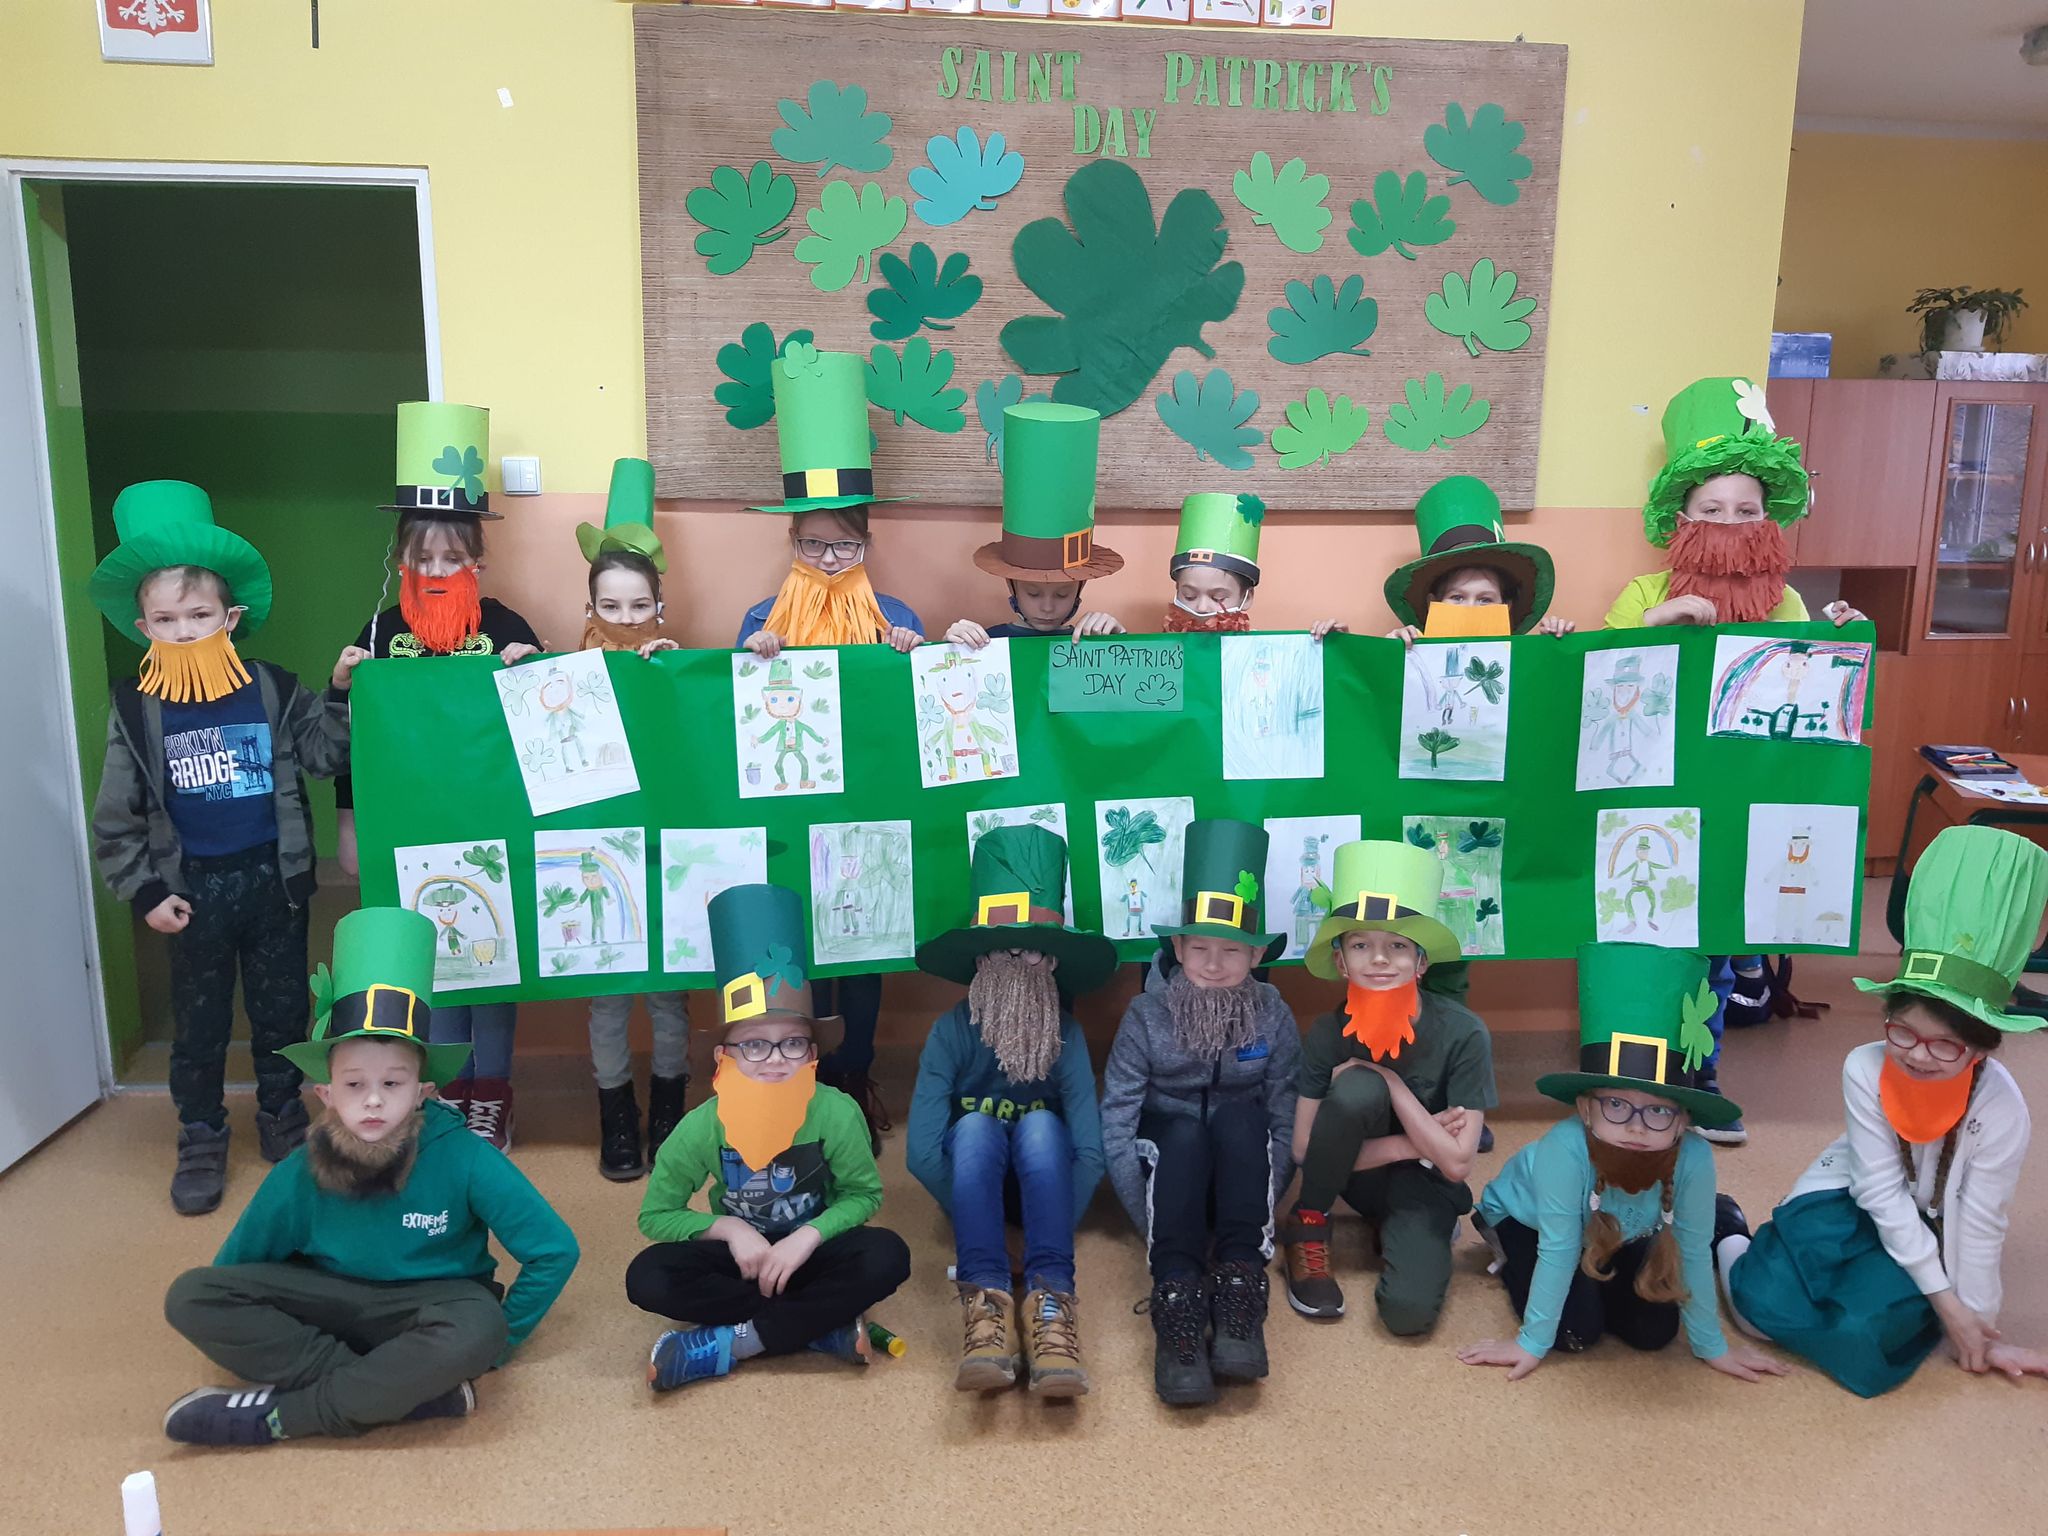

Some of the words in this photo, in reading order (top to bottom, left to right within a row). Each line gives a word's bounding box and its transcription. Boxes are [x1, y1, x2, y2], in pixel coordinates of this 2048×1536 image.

[937, 46, 1081, 103] SAINT
[1163, 51, 1393, 116] PATRICK'S
[1072, 104, 1157, 158] DAY
[1052, 643, 1105, 668] SAINT
[1108, 644, 1184, 670] PATRICK'S
[1083, 673, 1126, 696] DAY
[169, 749, 241, 789] BRIDGE
[205, 782, 232, 801] NYC
[402, 1209, 448, 1230] EXTREME
